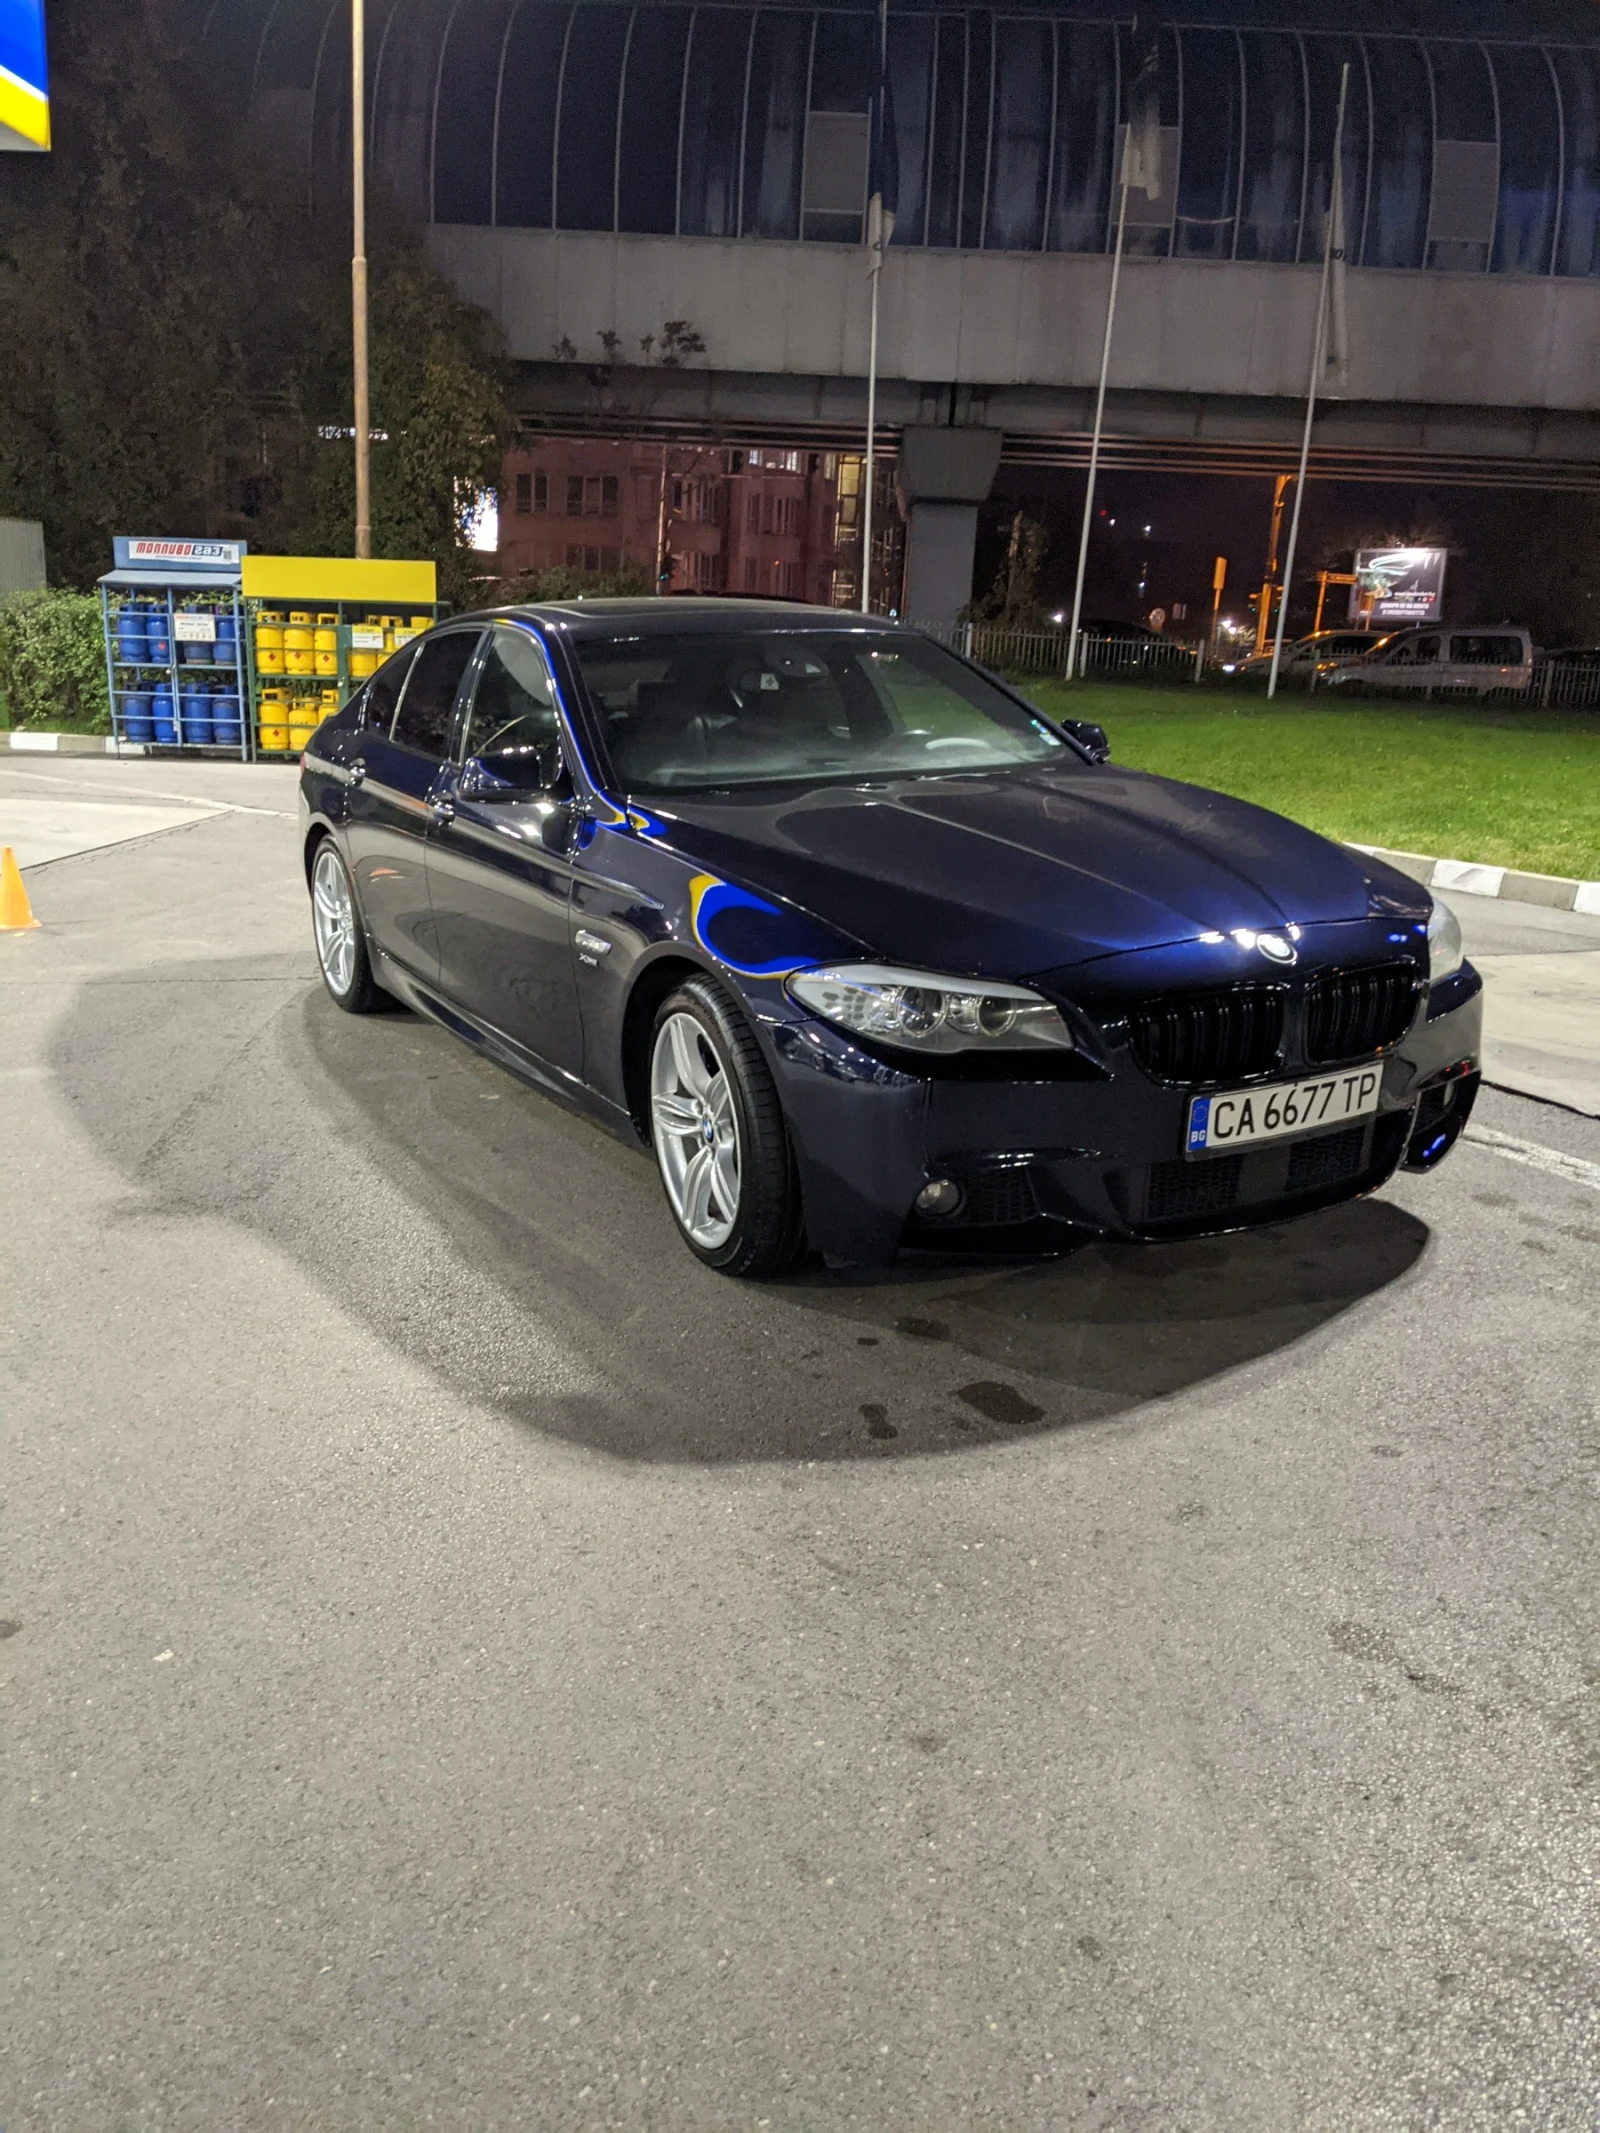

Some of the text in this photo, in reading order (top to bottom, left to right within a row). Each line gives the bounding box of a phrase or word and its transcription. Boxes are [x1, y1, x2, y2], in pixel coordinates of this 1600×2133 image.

[1214, 1072, 1377, 1139] CA 6677 TP
[1190, 1129, 1206, 1144] BG
